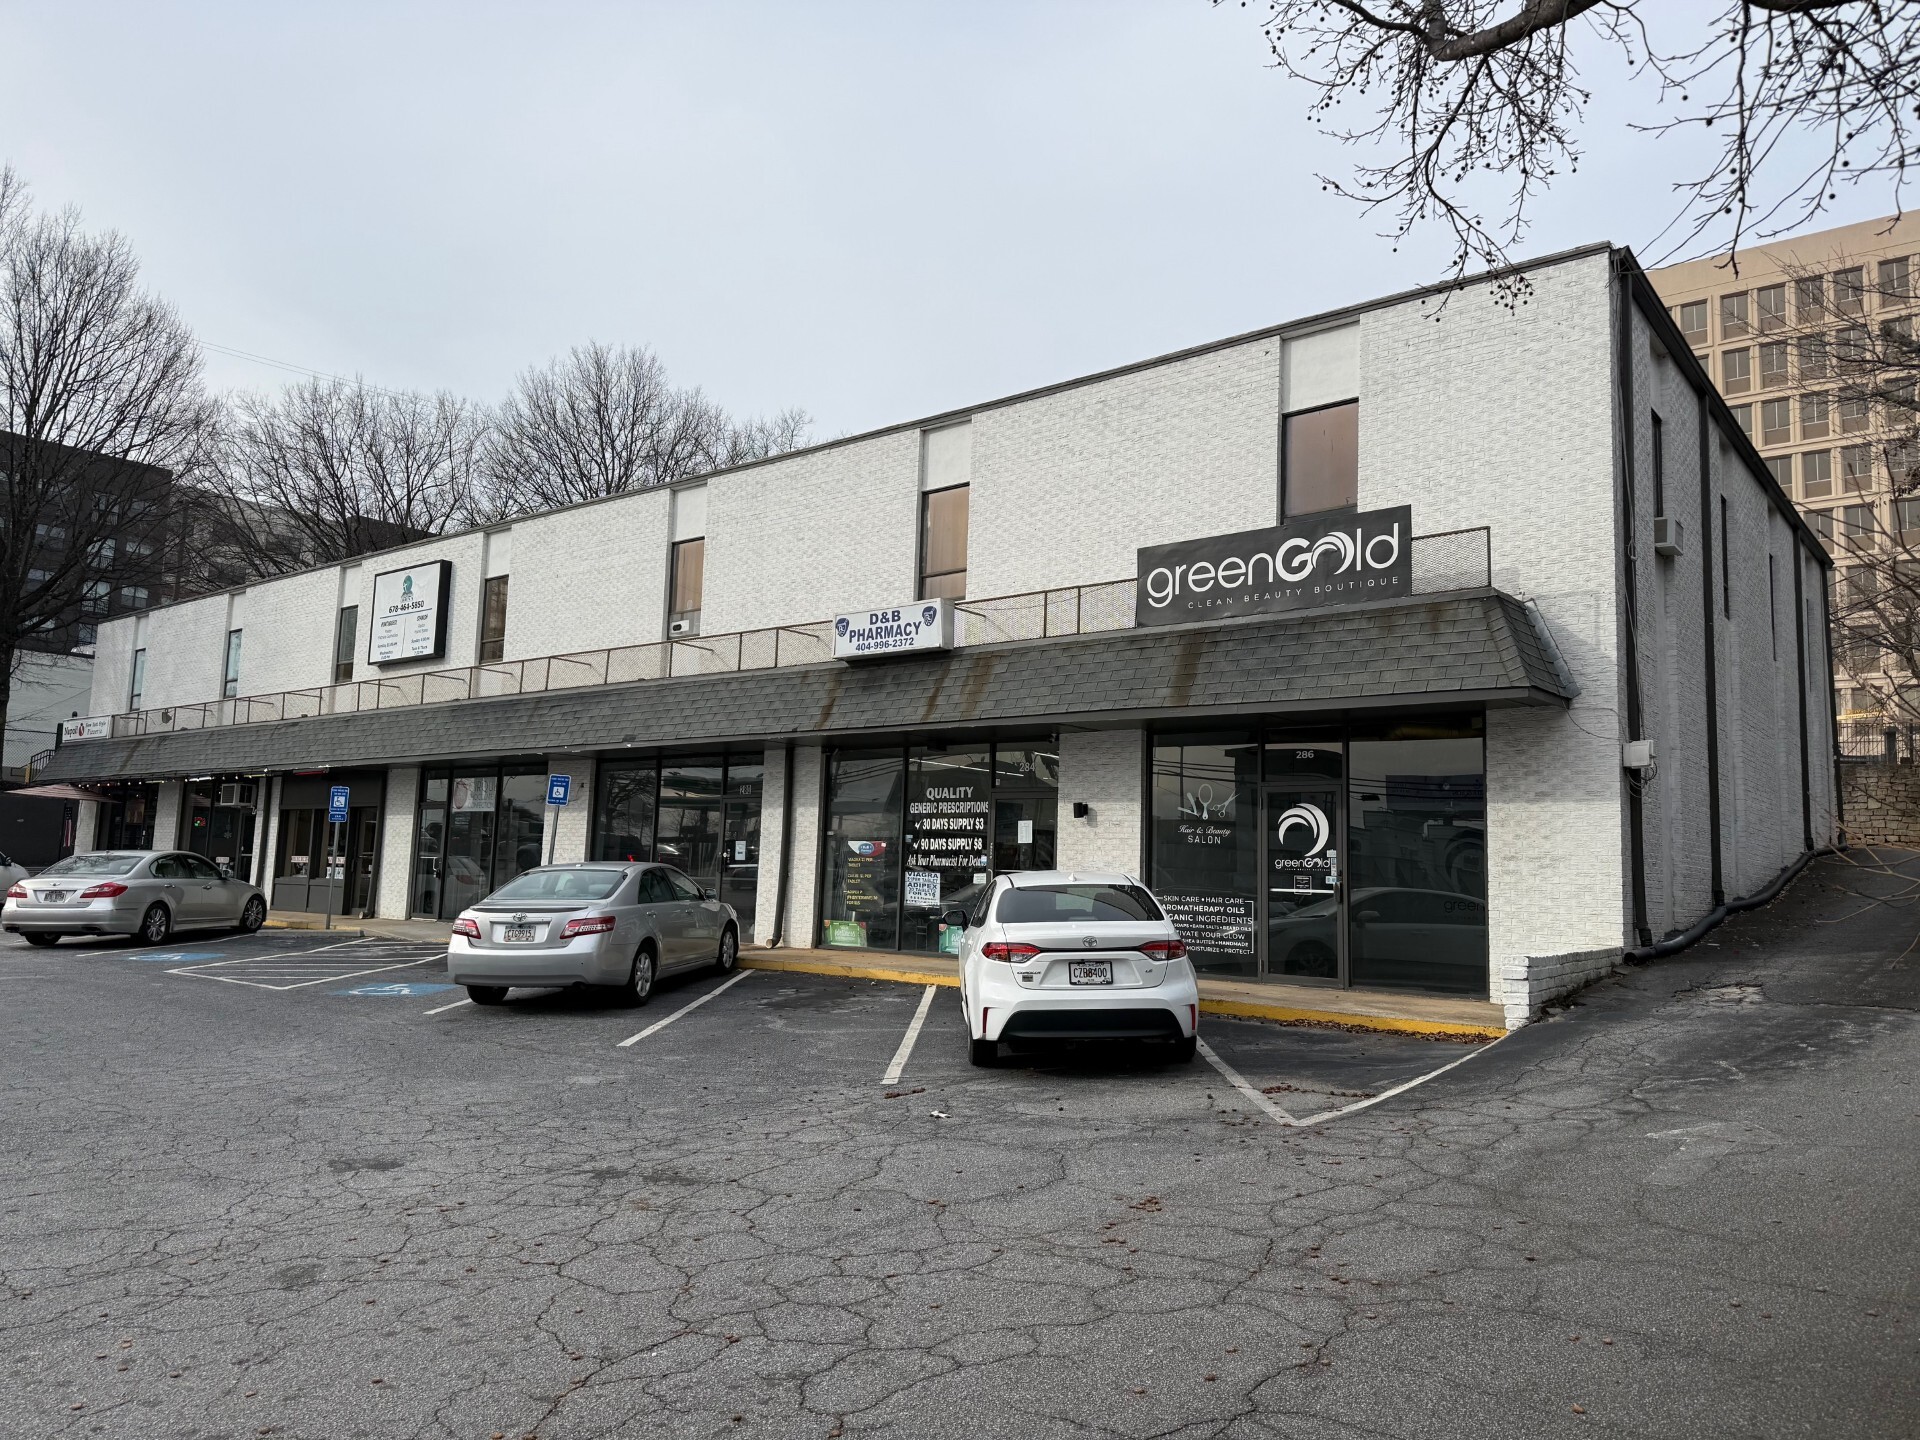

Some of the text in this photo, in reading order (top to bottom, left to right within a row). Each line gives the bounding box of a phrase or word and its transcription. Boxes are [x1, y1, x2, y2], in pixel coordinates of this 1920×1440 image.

[1146, 522, 1399, 608] greenGold
[1188, 576, 1399, 609] CLEAN BEAUTY BOUTIQUE
[869, 610, 901, 626] D&B
[849, 621, 922, 643] PHARMACY
[856, 637, 914, 651] 404-996-2372
[1296, 751, 1314, 759] 286
[1019, 762, 1035, 772] 284
[926, 786, 974, 800] QUALITY
[910, 801, 989, 814] GENERIC PRESCRIPTIONS
[922, 817, 984, 830] 30 DAYS SUPPLY $3
[1178, 825, 1195, 833] Hair
[1205, 826, 1231, 837] Beauty
[920, 838, 929, 850] 90
[930, 838, 947, 850] DAYS
[947, 838, 973, 850] SUPPLY
[973, 837, 982, 851] $8
[1187, 835, 1221, 844] SALON
[907, 854, 916, 866] Ask
[917, 854, 929, 866] Your
[929, 855, 958, 867] Pharmacist
[958, 855, 968, 867] For
[1161, 904, 1225, 913] AROMATHERAPY
[1196, 915, 1253, 925] INGREDIENTS
[1186, 945, 1220, 953] MOISTURIZE
